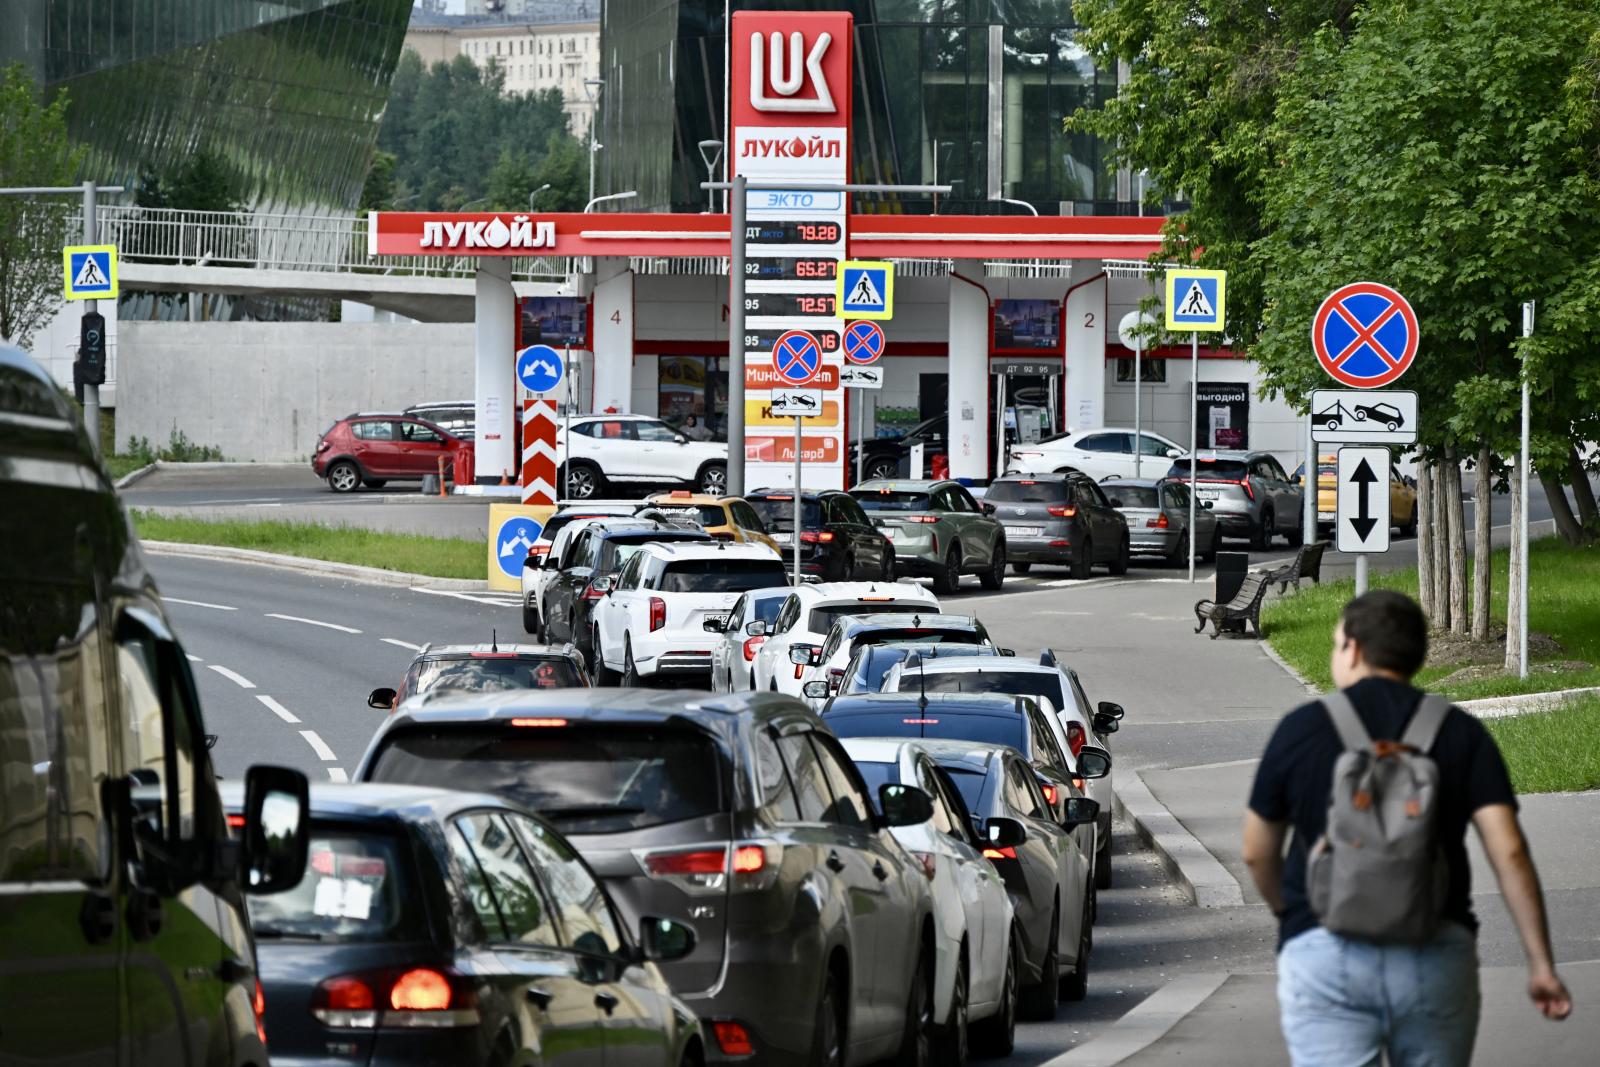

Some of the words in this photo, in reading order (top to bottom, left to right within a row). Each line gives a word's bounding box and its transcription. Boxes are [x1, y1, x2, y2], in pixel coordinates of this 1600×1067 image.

[741, 136, 840, 158] ЛУКОЙЛ
[768, 193, 814, 207] ЭКТО
[420, 215, 556, 248] ЛУКОЙЛ
[745, 227, 761, 239] ДТ
[797, 225, 837, 241] 79.28
[745, 263, 760, 274] 92
[796, 261, 837, 277] 65.27
[744, 299, 760, 310] 95
[796, 297, 836, 312] 72.57
[610, 309, 621, 325] 4
[1084, 312, 1095, 328] 2
[744, 335, 760, 346] 95
[1006, 365, 1019, 374] ДТ
[1023, 365, 1034, 374] 92
[1039, 365, 1049, 374] 95
[782, 447, 825, 461] Лиард
